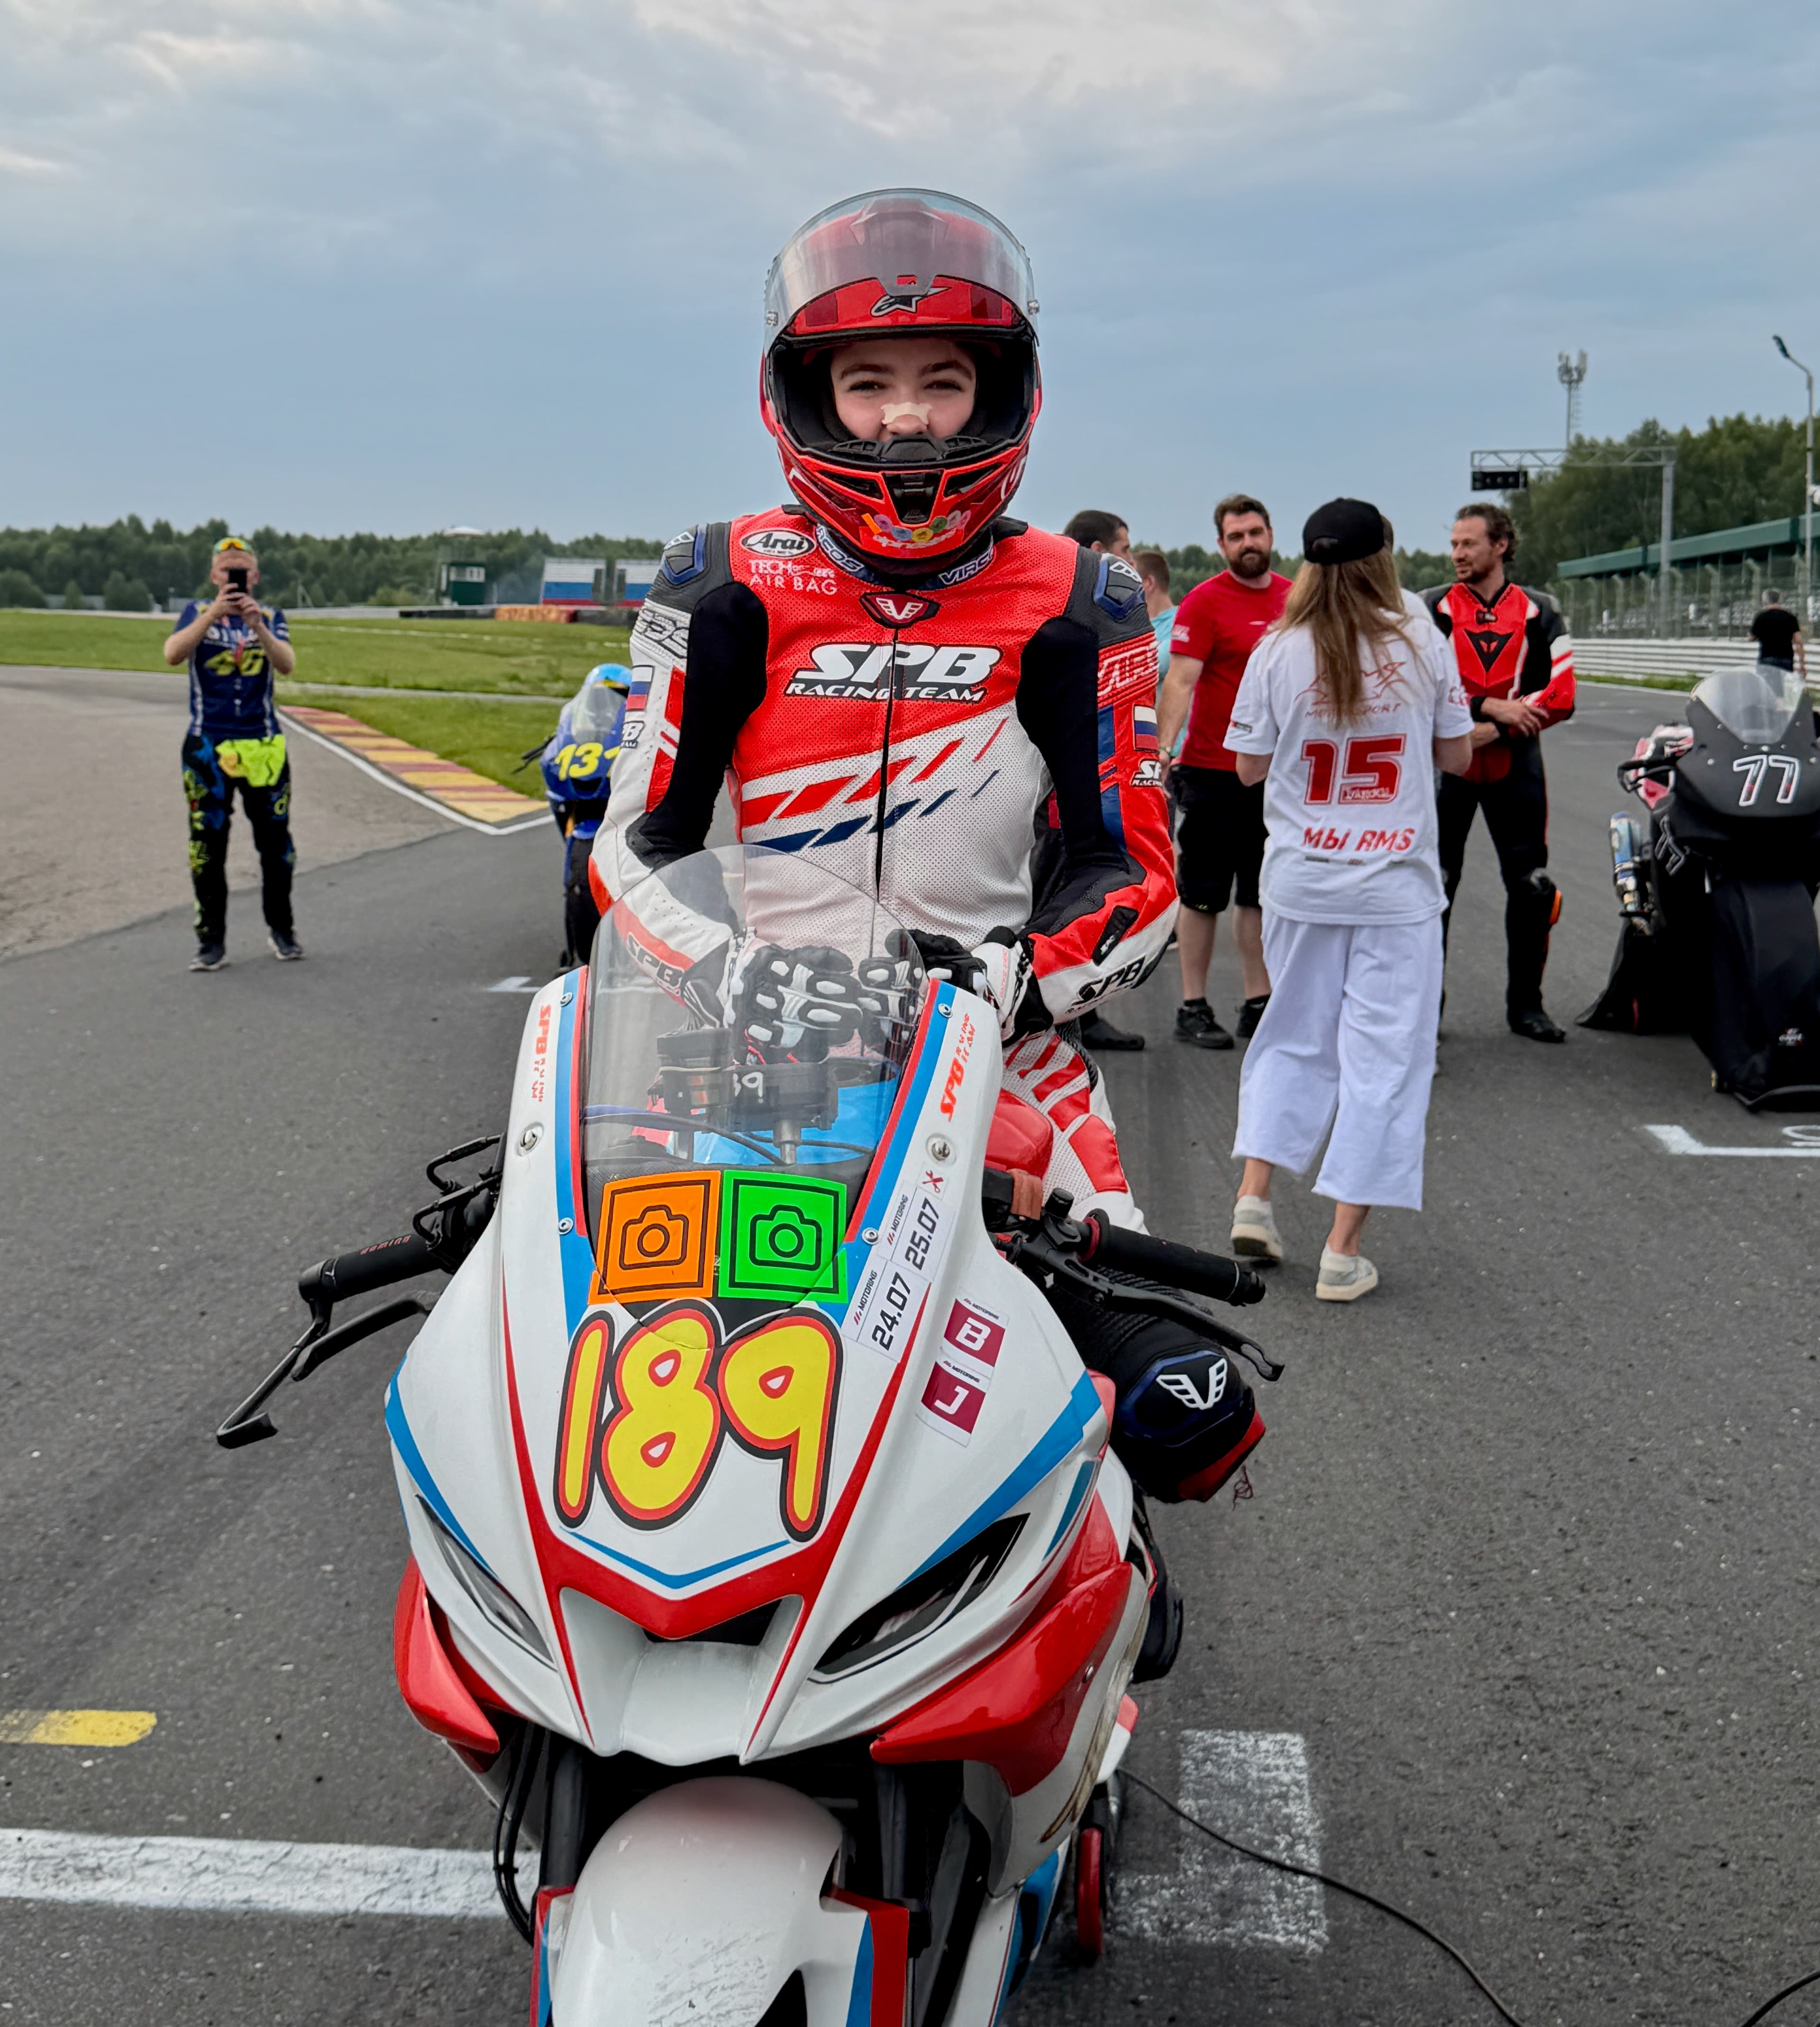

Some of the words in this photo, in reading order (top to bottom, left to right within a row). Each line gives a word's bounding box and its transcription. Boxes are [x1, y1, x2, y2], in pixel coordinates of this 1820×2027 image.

[746, 533, 806, 550] Arai
[749, 575, 785, 588] AIR
[793, 576, 837, 595] BAG
[796, 644, 1001, 684] SPB
[786, 683, 895, 699] RACING
[905, 687, 984, 701] TEAM
[1301, 733, 1407, 805] 15
[1733, 754, 1800, 806] 77
[1355, 828, 1415, 852] RMS
[536, 1004, 551, 1055] SPB
[940, 1057, 964, 1122] SPB
[891, 1194, 908, 1232] MOTORING
[905, 1197, 939, 1270] 25.07
[858, 1269, 877, 1311] MOTORING
[872, 1272, 910, 1351] 24.07
[972, 1303, 999, 1320] MOTORING
[956, 1316, 991, 1351] B
[952, 1365, 980, 1383] MOTORING
[934, 1385, 969, 1415] J
[554, 1298, 843, 1543] 189
